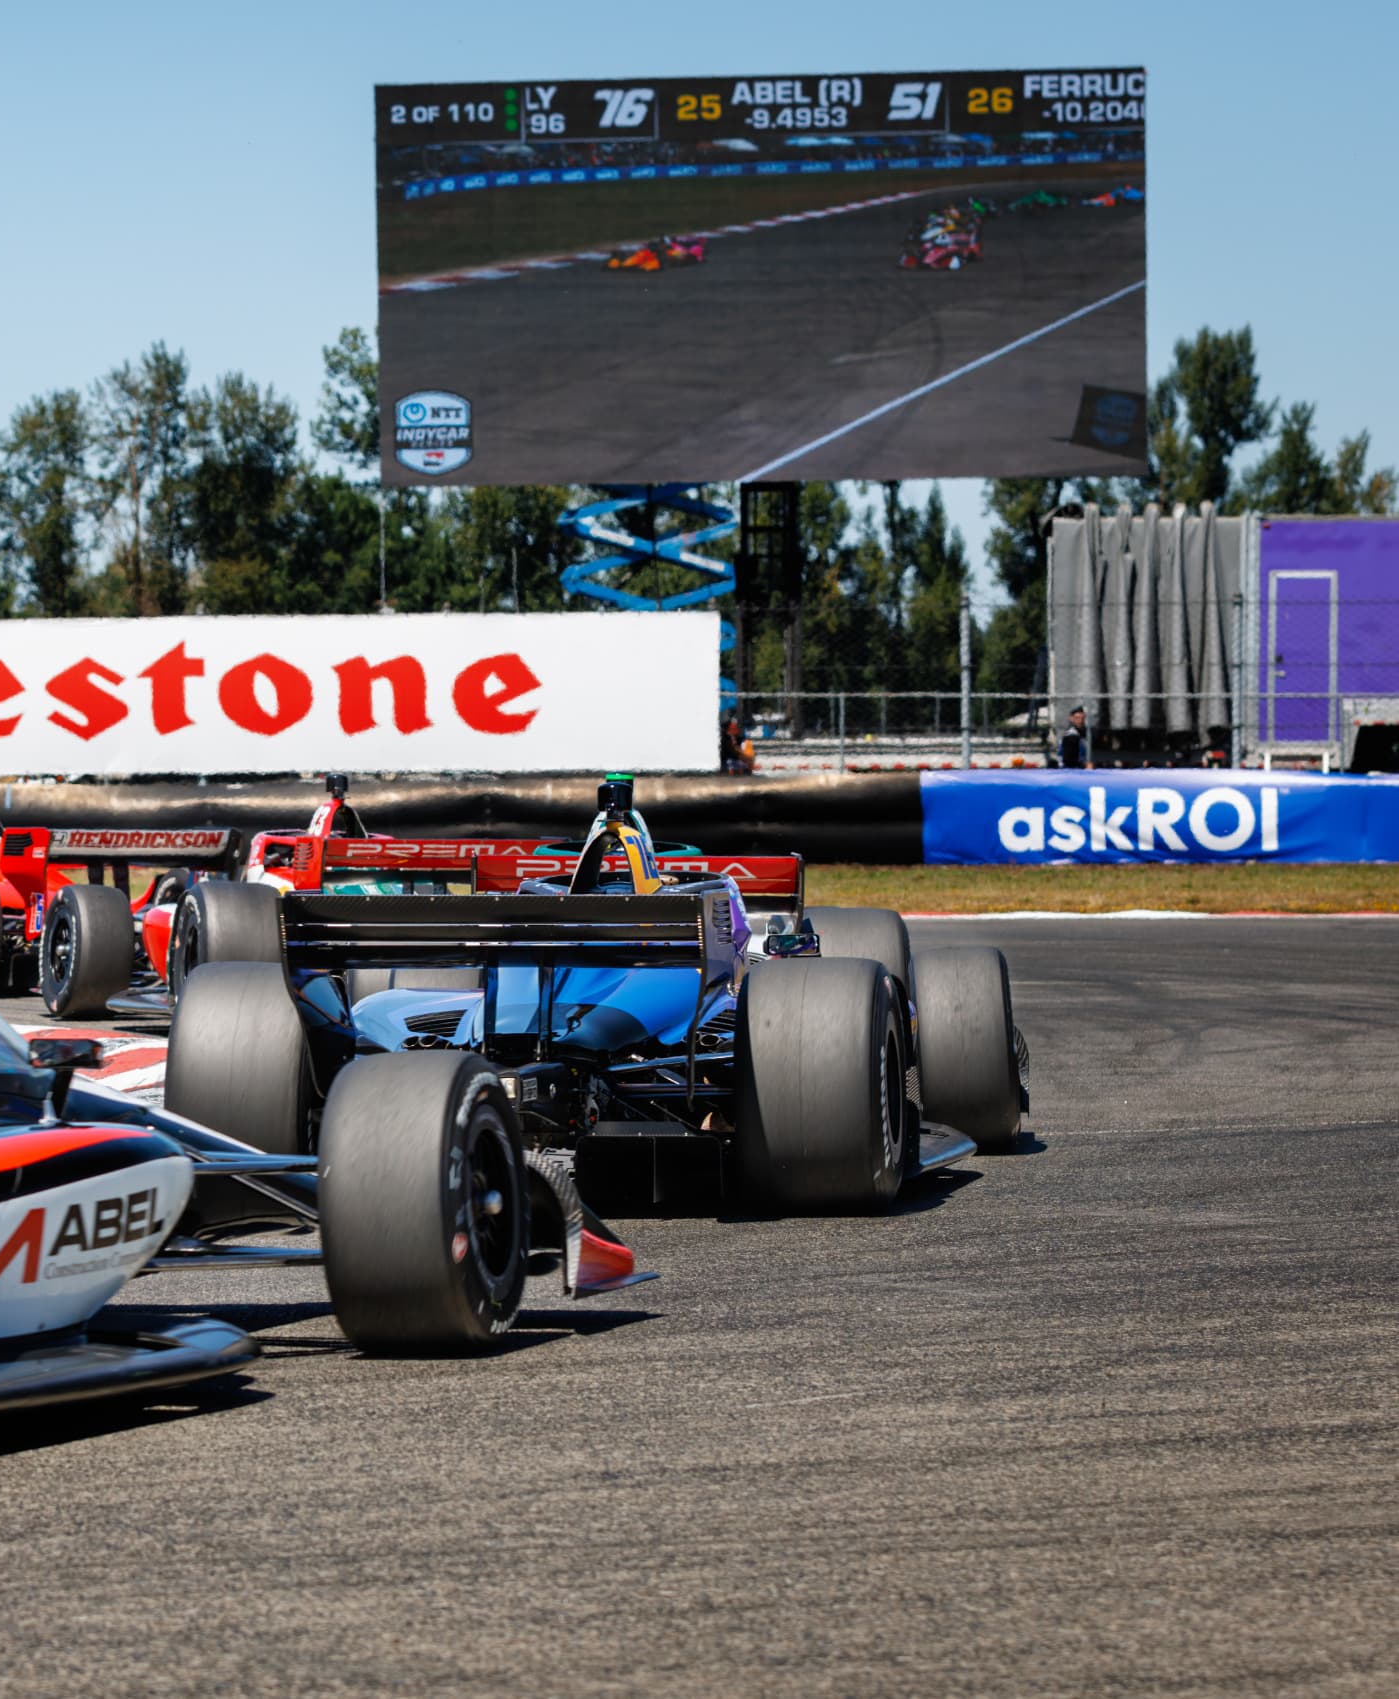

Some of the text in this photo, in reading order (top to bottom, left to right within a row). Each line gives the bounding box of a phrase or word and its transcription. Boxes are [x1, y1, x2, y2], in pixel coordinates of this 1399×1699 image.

[731, 78, 862, 107] ABEL (R)
[1023, 73, 1145, 98] FERRUC
[391, 103, 495, 124] 2 OF 110
[594, 88, 655, 128] 76
[677, 94, 722, 121] 25
[887, 82, 942, 120] 51
[967, 87, 1014, 115] 26
[1042, 101, 1145, 123] -10.204
[745, 106, 848, 129] -9.4953
[430, 406, 462, 419] NTT
[396, 426, 470, 442] INDYCAR
[997, 786, 1280, 853] askROI
[67, 829, 225, 849] HENDRICKSON
[346, 843, 529, 858] PREMA
[48, 1187, 166, 1257] ABEL
